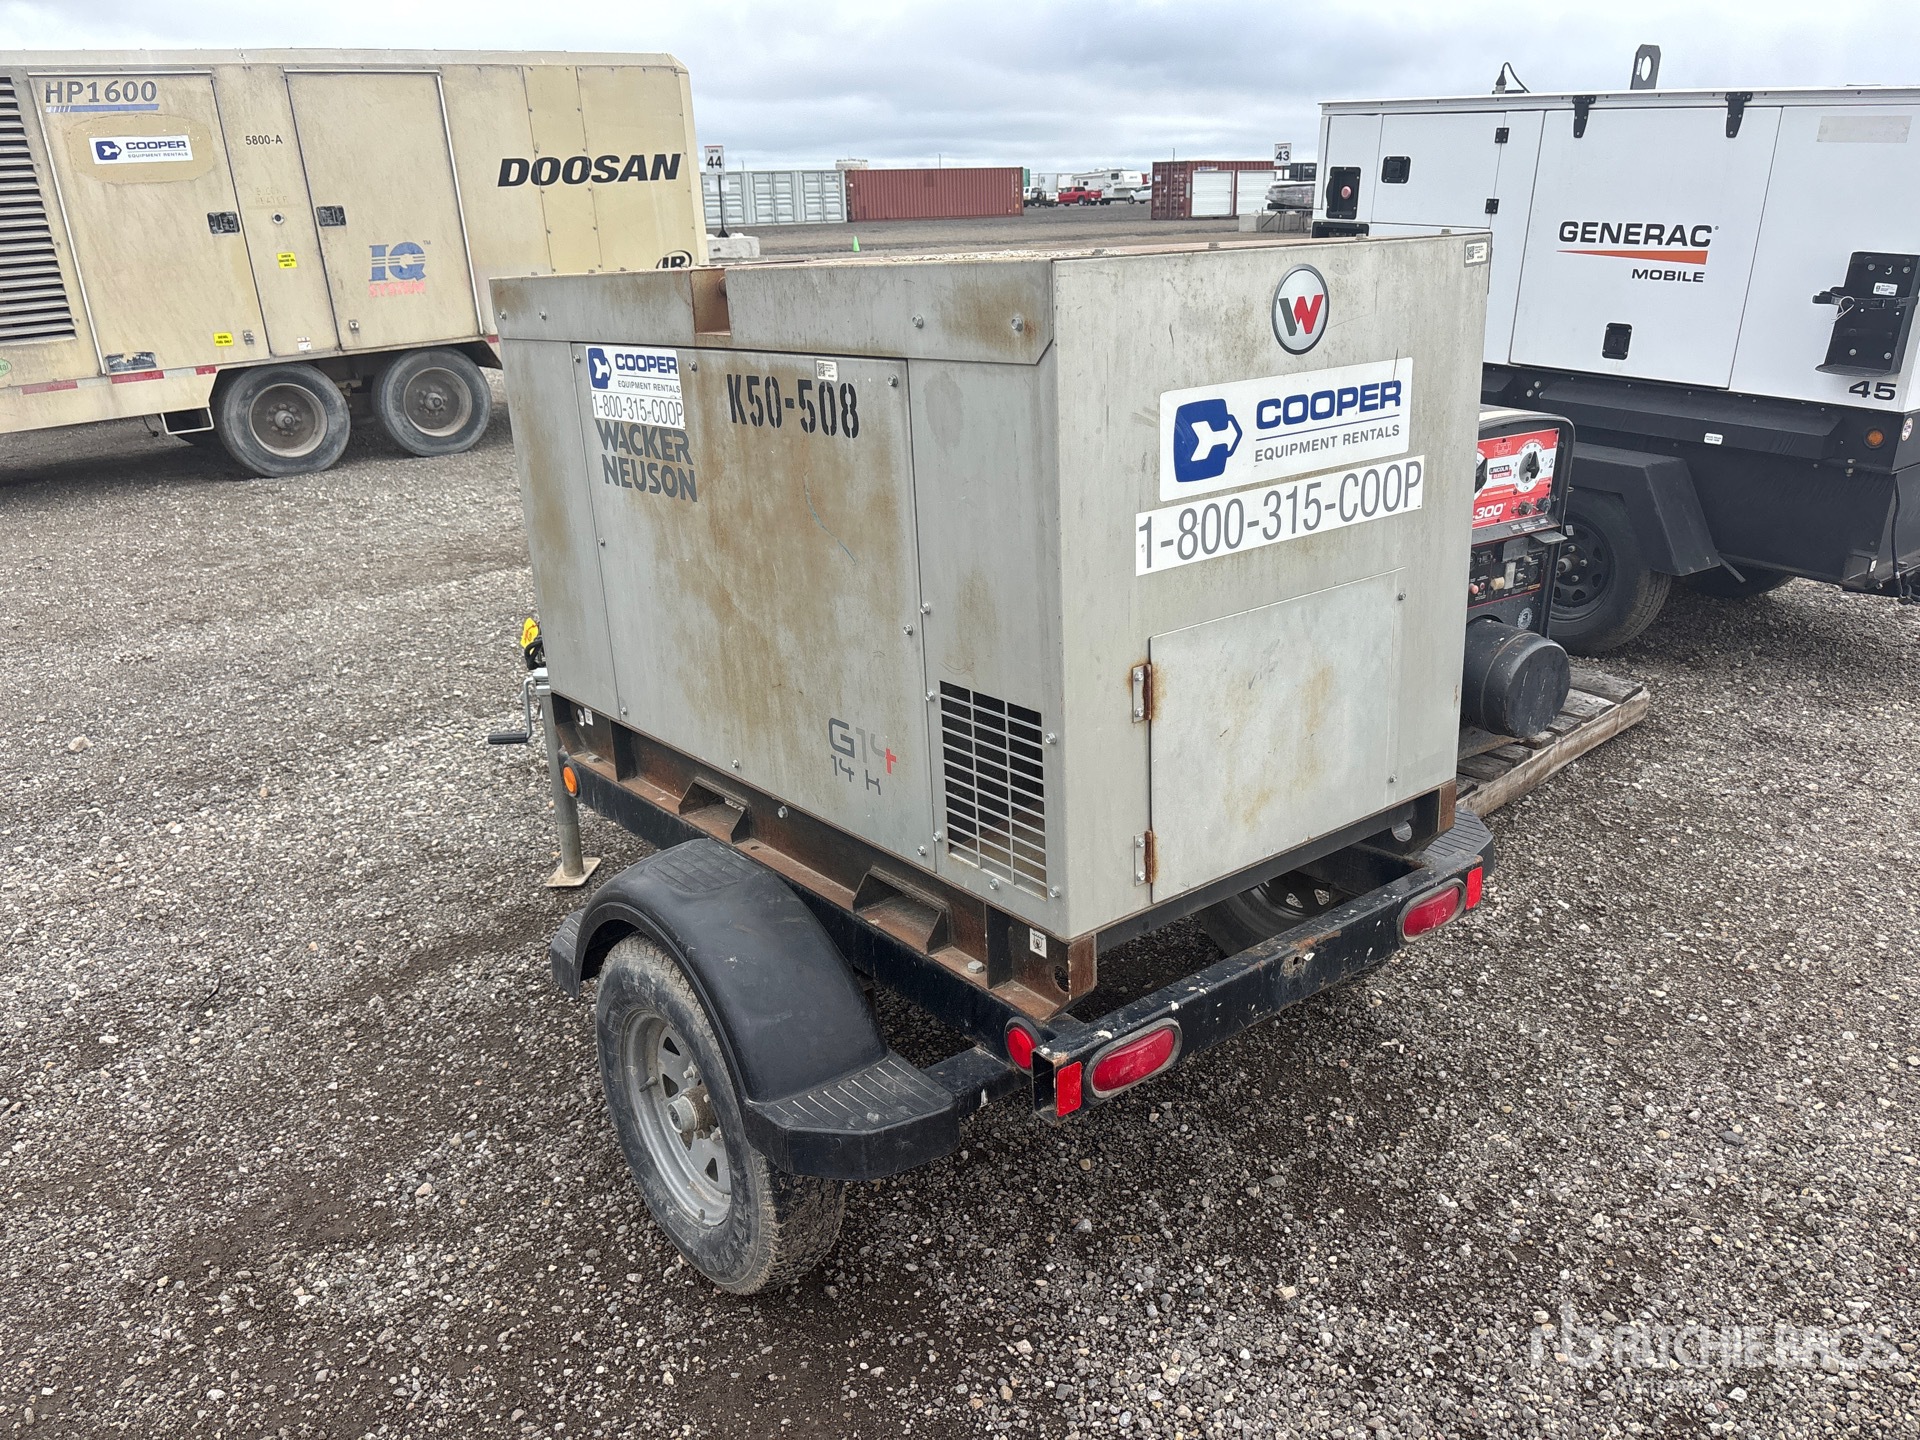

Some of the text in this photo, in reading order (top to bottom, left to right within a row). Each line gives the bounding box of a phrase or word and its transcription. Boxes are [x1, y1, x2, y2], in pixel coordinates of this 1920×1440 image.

[46, 80, 157, 104] HP1600
[126, 140, 187, 151] COOPER
[245, 134, 283, 146] 5800-A
[498, 153, 681, 187] DOOSAN
[707, 156, 722, 169] 44
[1276, 151, 1290, 161] 43
[369, 241, 426, 281] IQ
[1632, 268, 1705, 283] MOBILE
[615, 353, 678, 374] COOPER
[618, 380, 681, 394] EQUIPMENT RENTALS
[1849, 381, 1897, 400] 45
[592, 394, 683, 427] 1-800-315-COOP
[727, 374, 860, 439] K50-508
[1256, 380, 1402, 430] COOPER
[596, 420, 694, 465] WACKER
[1255, 424, 1400, 463] EQUIPMENT RENTALS
[602, 455, 698, 502] NEUSON
[1139, 460, 1422, 569] 1-800-315-COOP
[831, 754, 855, 783] 14
